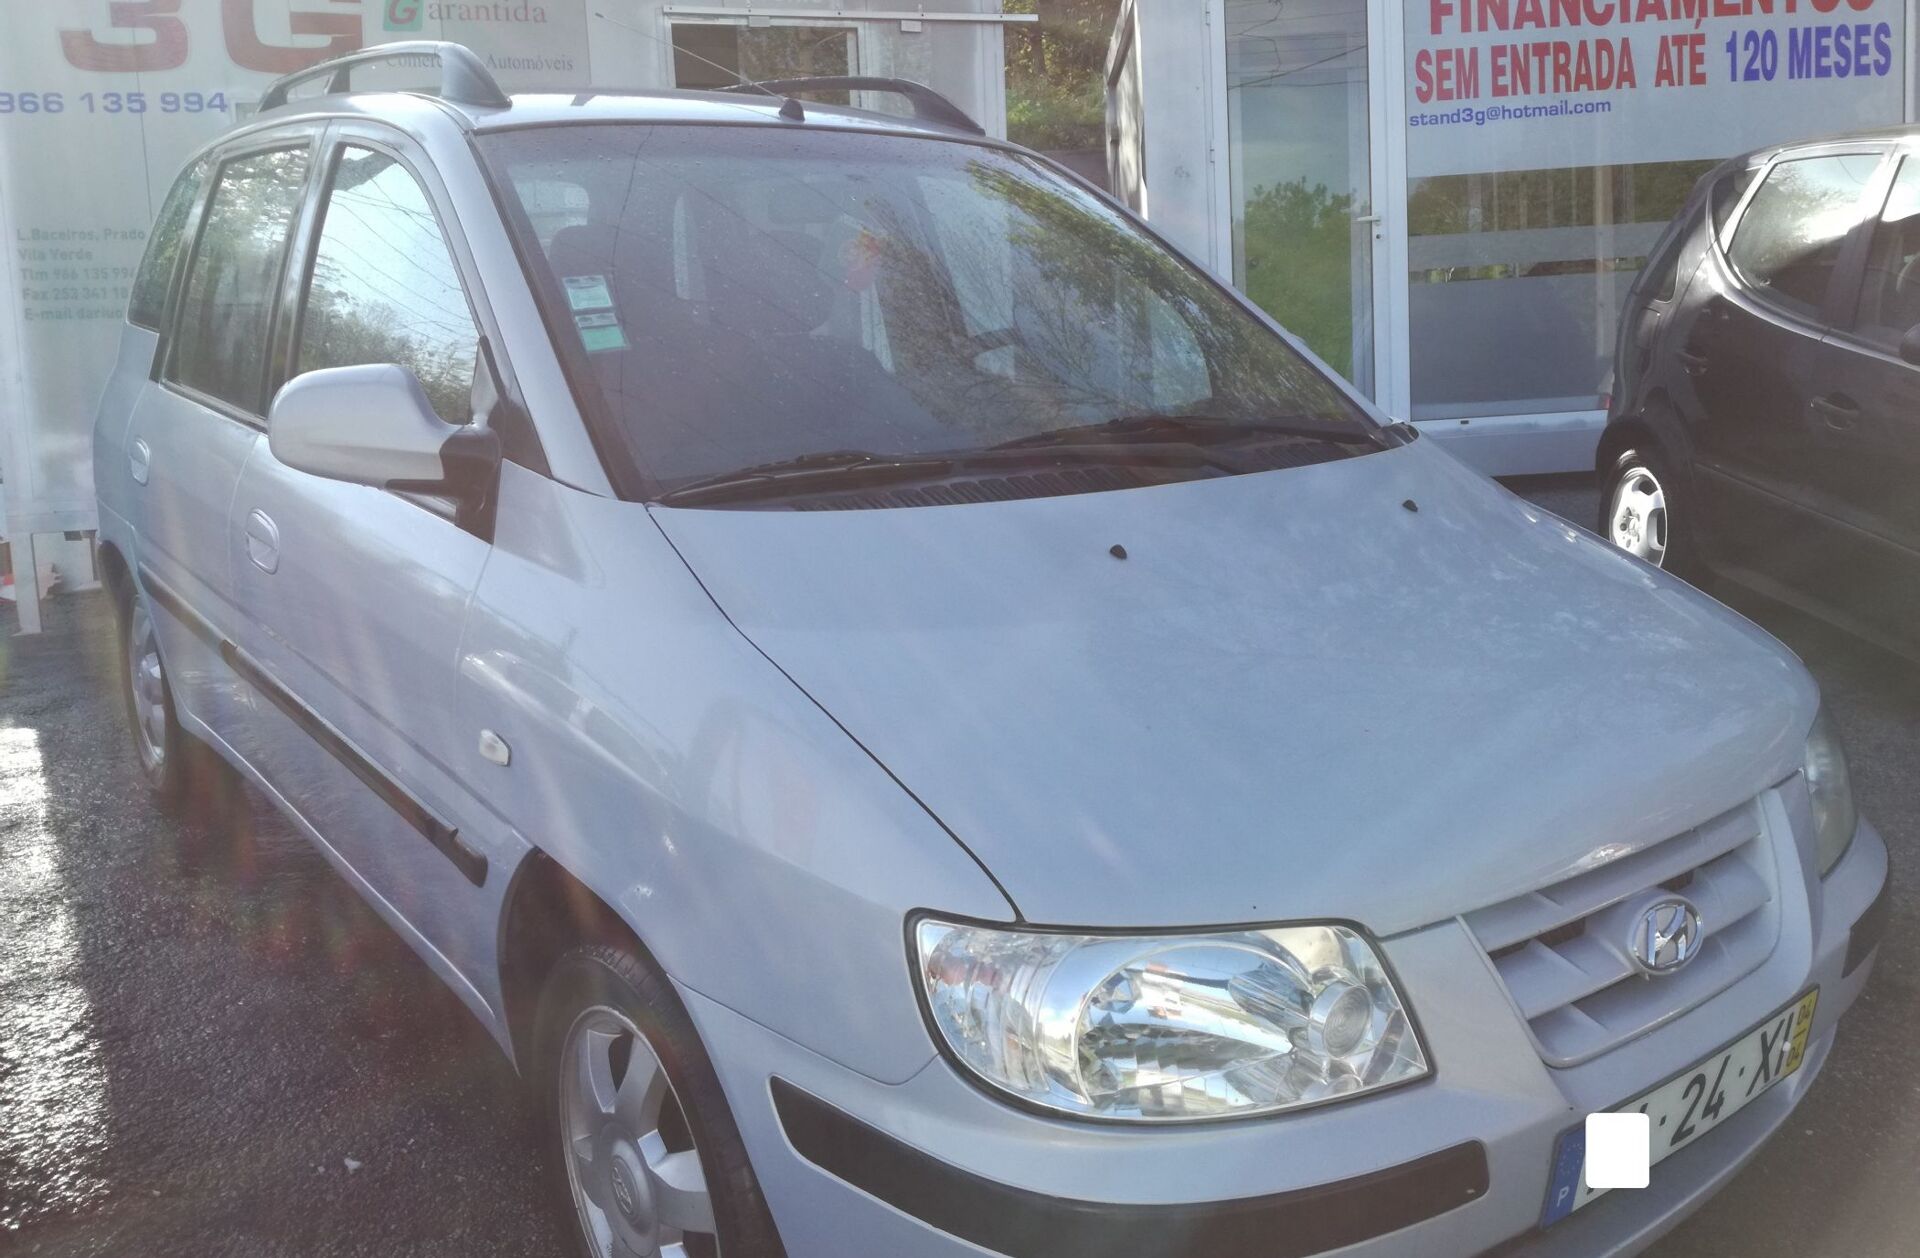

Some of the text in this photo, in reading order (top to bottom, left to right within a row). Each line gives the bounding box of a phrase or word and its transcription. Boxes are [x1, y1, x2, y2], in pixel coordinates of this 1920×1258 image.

[1430, 0, 1875, 35] FINANCIA
[1415, 18, 1892, 104] SEM ENTRADA ATÉ 120 MESES
[80, 92, 147, 114] 135
[160, 92, 228, 114] 994
[1409, 100, 1611, 127] stand3g@hotmail.com
[104, 228, 146, 241] Prado
[18, 249, 94, 261] Vila Verde
[84, 268, 109, 281] 135
[25, 308, 73, 321] E-mail
